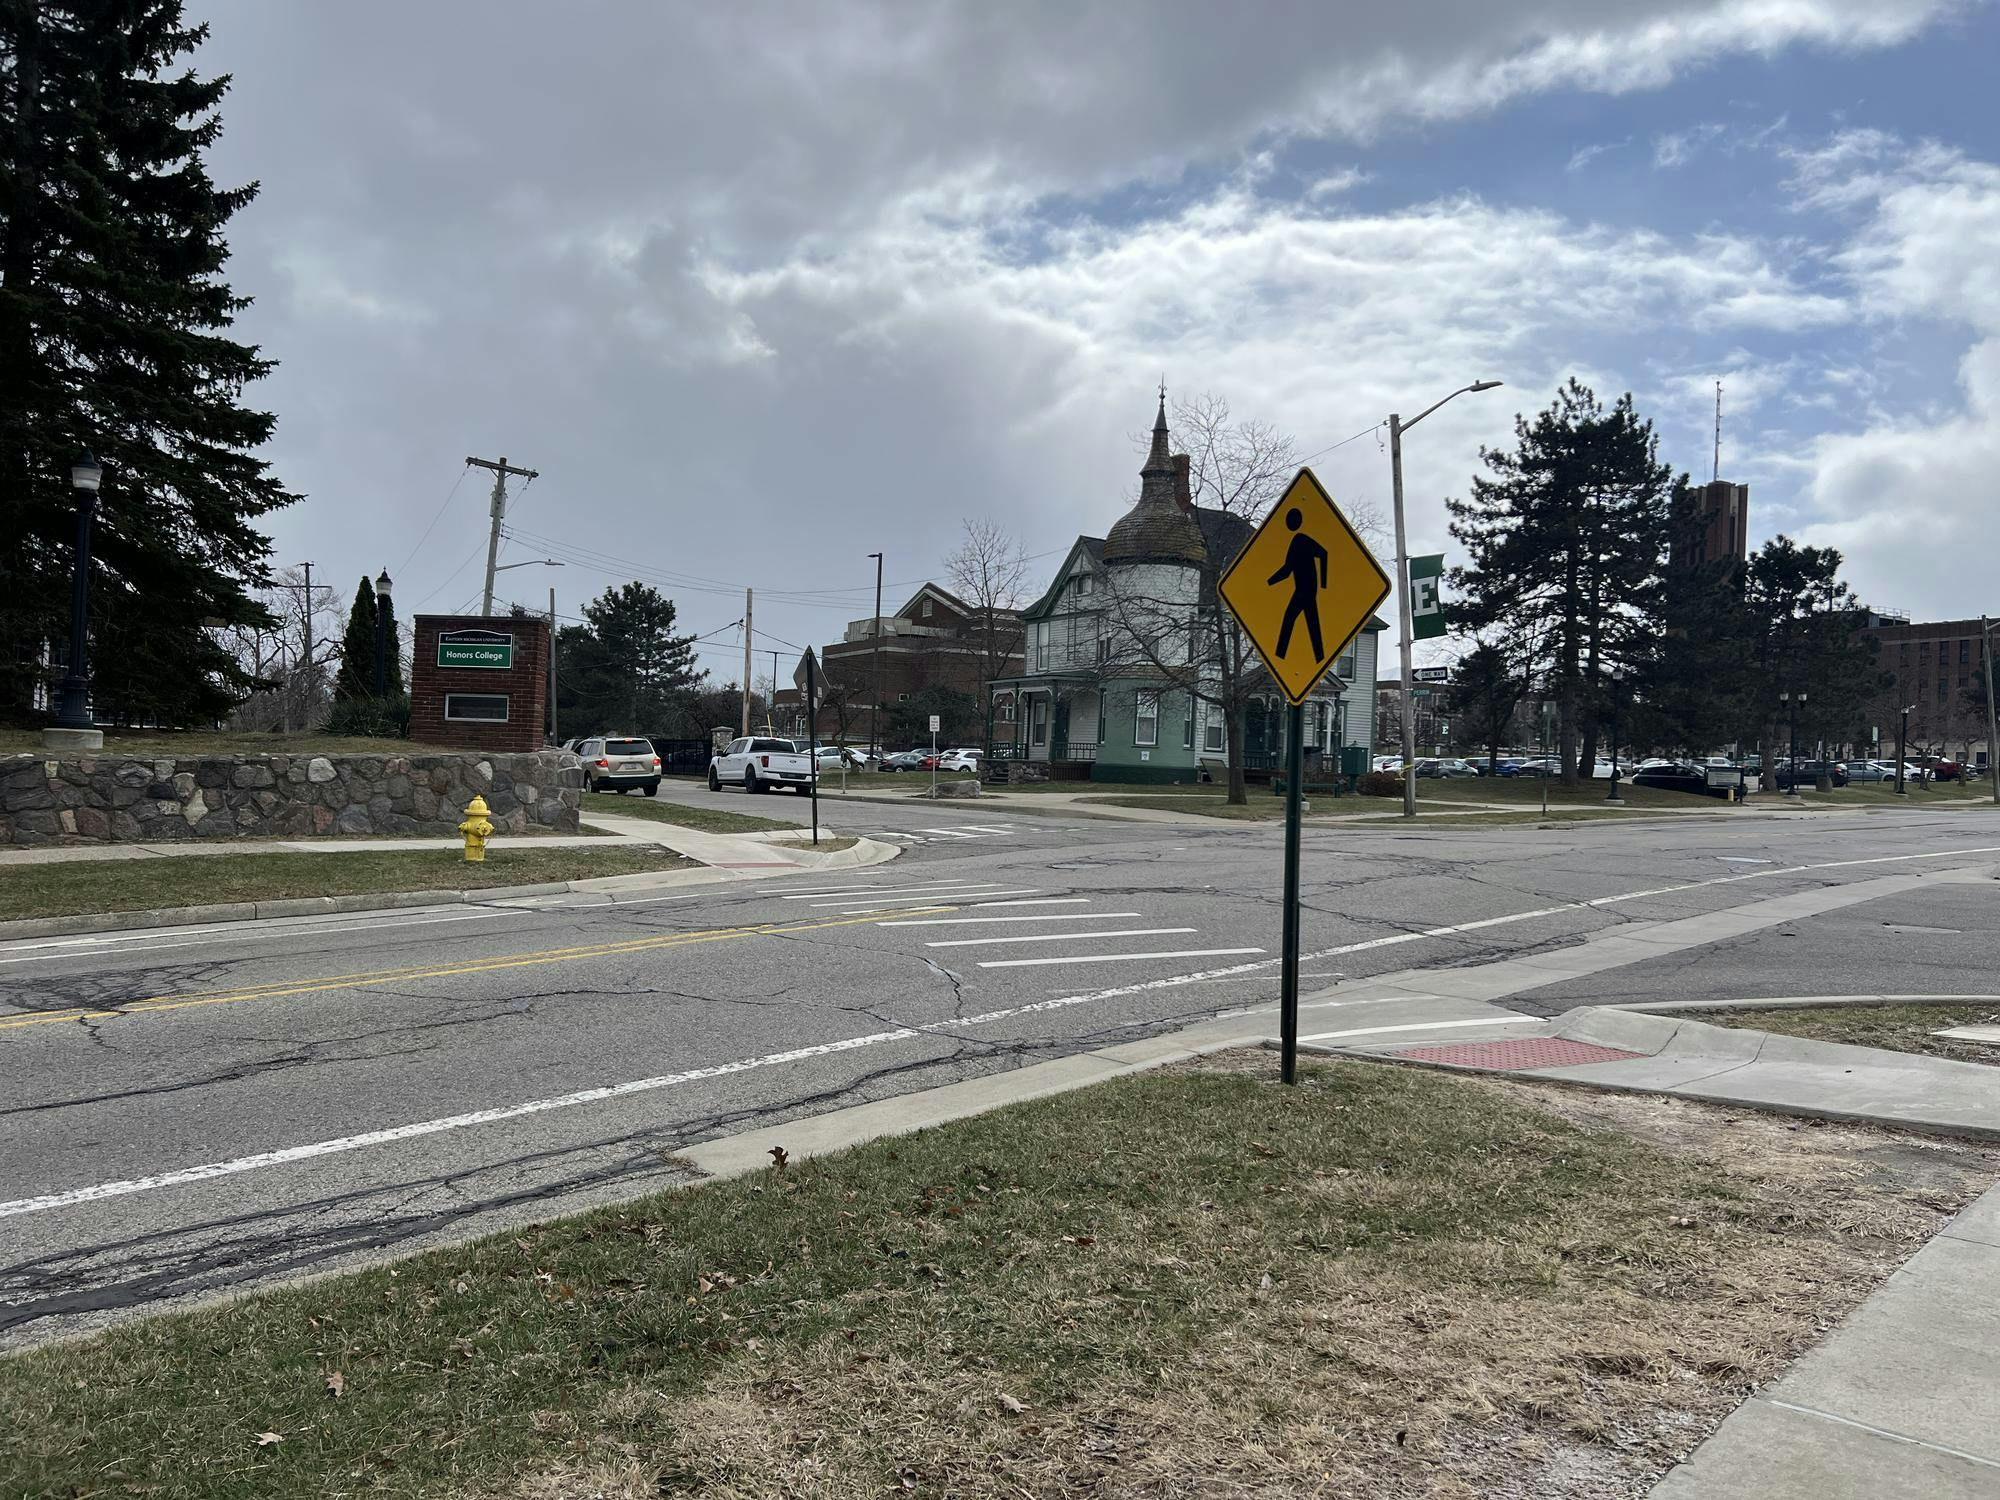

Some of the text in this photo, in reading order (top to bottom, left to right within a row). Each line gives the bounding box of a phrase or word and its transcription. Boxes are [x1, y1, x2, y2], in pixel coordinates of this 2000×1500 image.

[1412, 576, 1438, 617] E
[446, 650, 503, 661] Honors College
